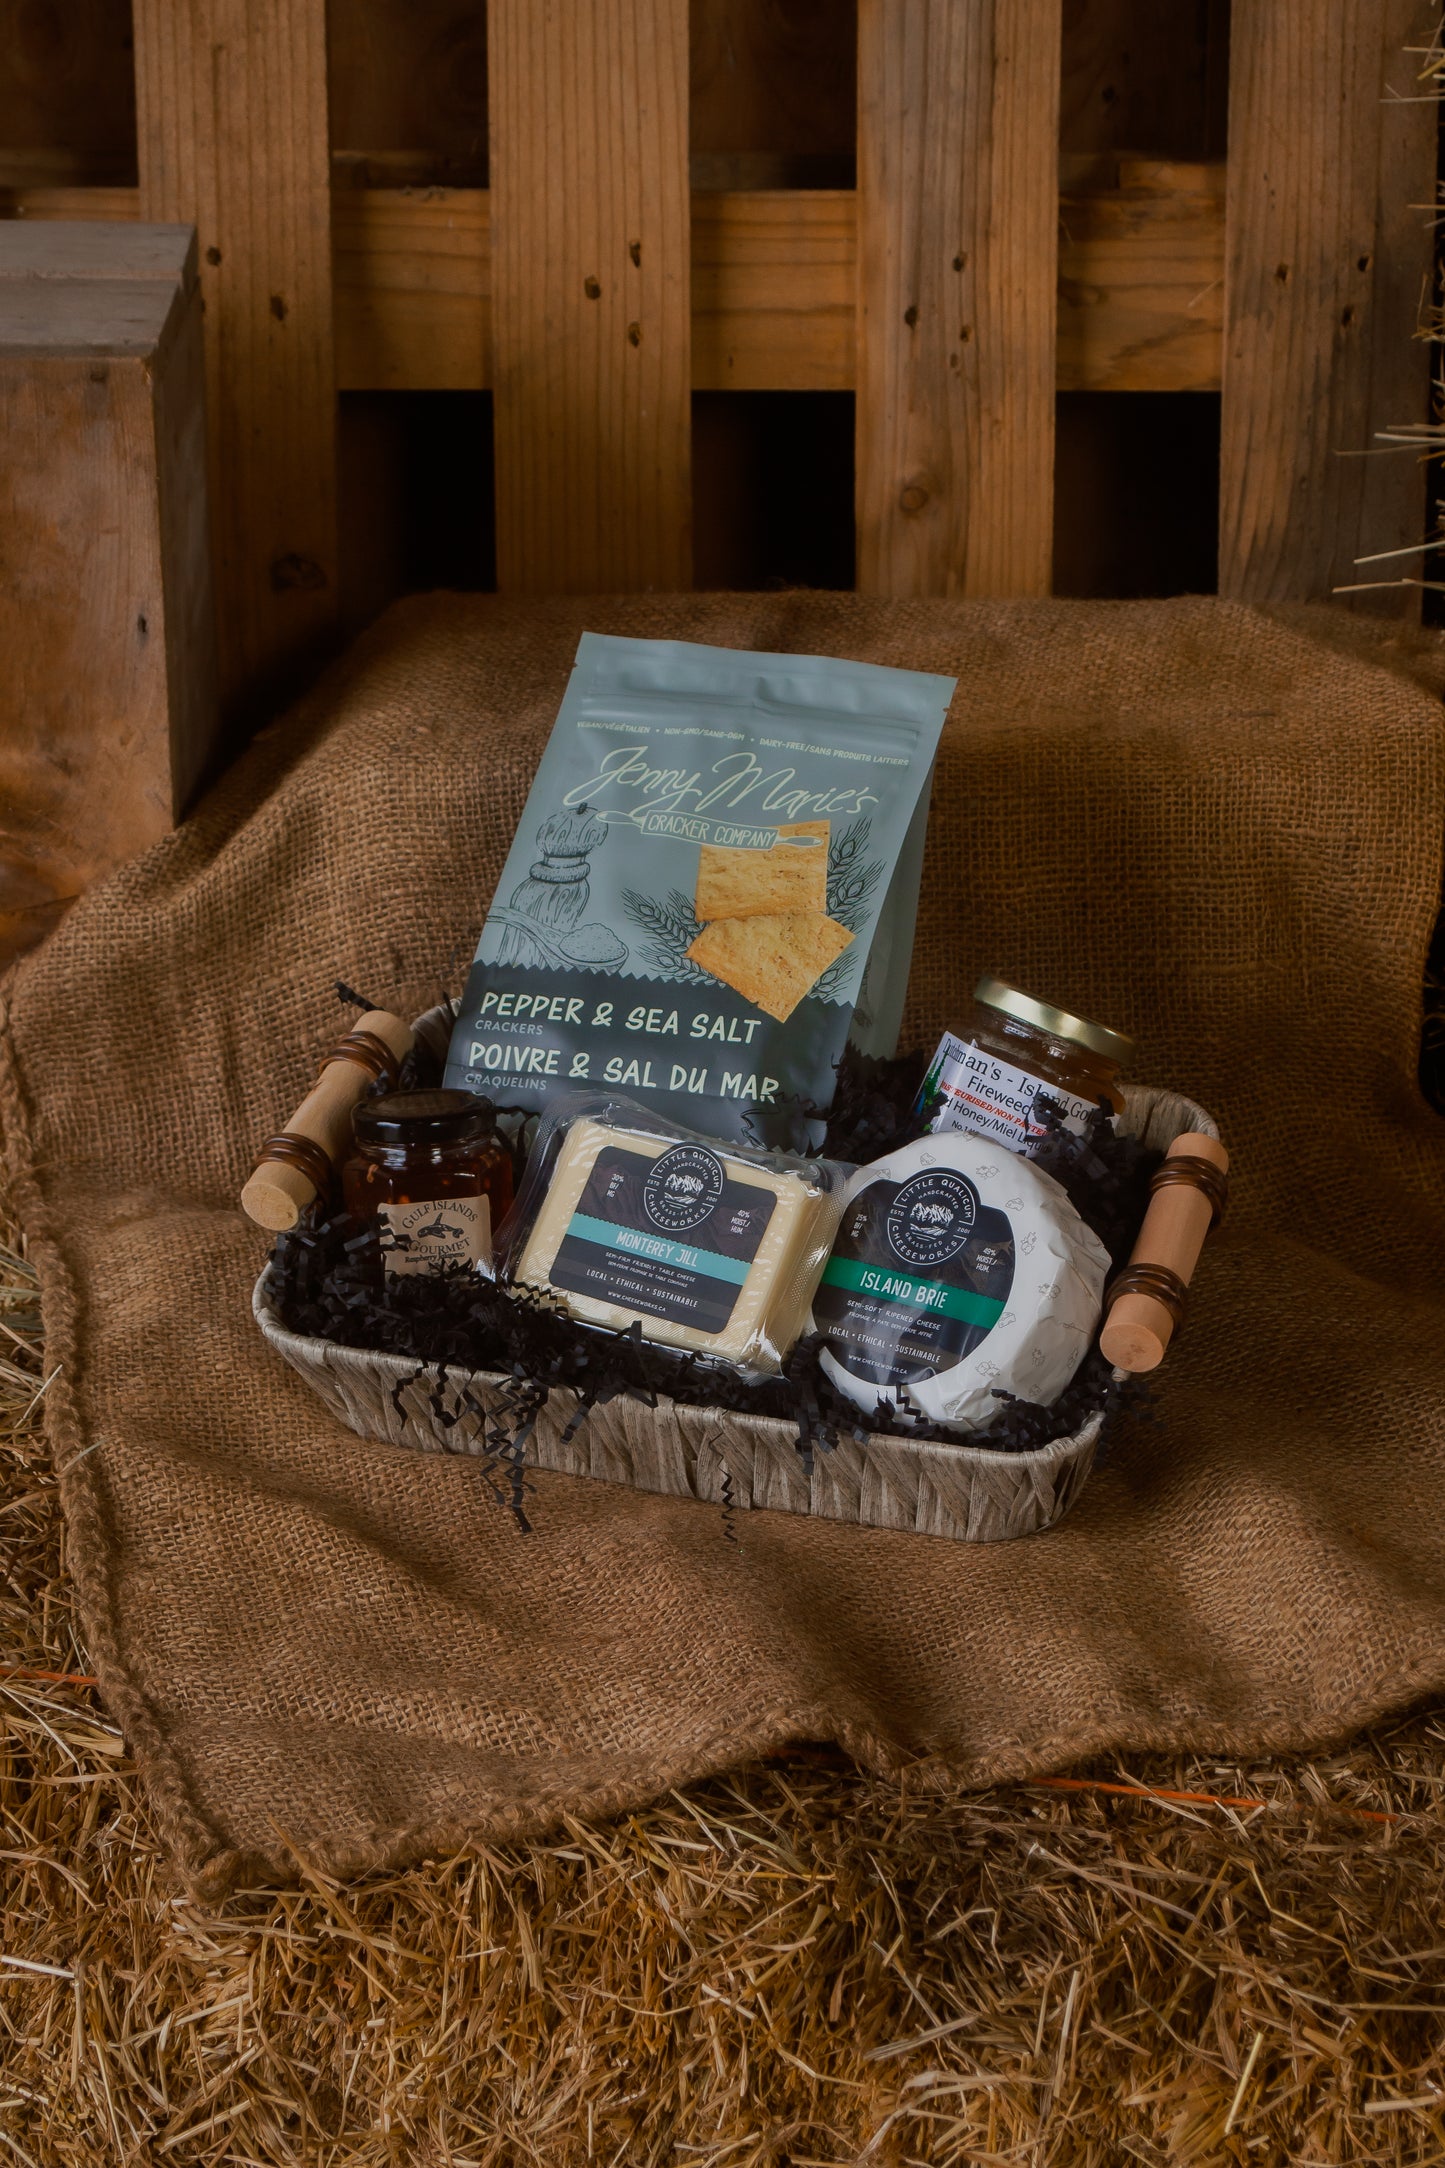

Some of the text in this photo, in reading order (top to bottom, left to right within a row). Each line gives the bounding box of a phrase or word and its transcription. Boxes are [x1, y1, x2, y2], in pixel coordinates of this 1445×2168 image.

[760, 737, 832, 756] DAIRY-FREE/SANS
[833, 749, 872, 762] PRODUITS
[873, 756, 910, 766] LAITIERS
[563, 745, 879, 819] Jenny Marie's
[647, 812, 776, 848] CRACKER COMPANY
[475, 1019, 544, 1036] CRACKERS
[480, 991, 762, 1044] PEPPER & SEA SALT
[464, 1072, 548, 1092] CRAQUELINS
[468, 1041, 780, 1104] POIVRE & SAL DU MAR
[953, 1100, 1019, 1139] Honey/Miel
[656, 1151, 720, 1188] LITTLE QUALICUM
[402, 1200, 479, 1229] GULF ISLANDS
[648, 1193, 706, 1227] CHEESEWORKS
[900, 1178, 972, 1219] LITTLE QUALICUM
[409, 1237, 471, 1255] GOURMET
[615, 1230, 699, 1267] MONTEREY JILL
[892, 1225, 958, 1261] CHEESEWORKS
[605, 1251, 697, 1283] SEMI-FIRM FRIENDLY TABLE CHEESE
[586, 1268, 699, 1308] LOCAL ETHICAL SUSTAINABLE
[607, 1290, 667, 1312] WWW.CHEESEWORKS.CA
[859, 1270, 949, 1309] ISLAND BRIE
[847, 1299, 942, 1331] SEMI-SOFT RIPENED CHEESE
[828, 1325, 941, 1364] LOCAL ETHICAL SUSTAINABLE
[848, 1353, 908, 1375] WWW.CHEESEWORKS.CA
